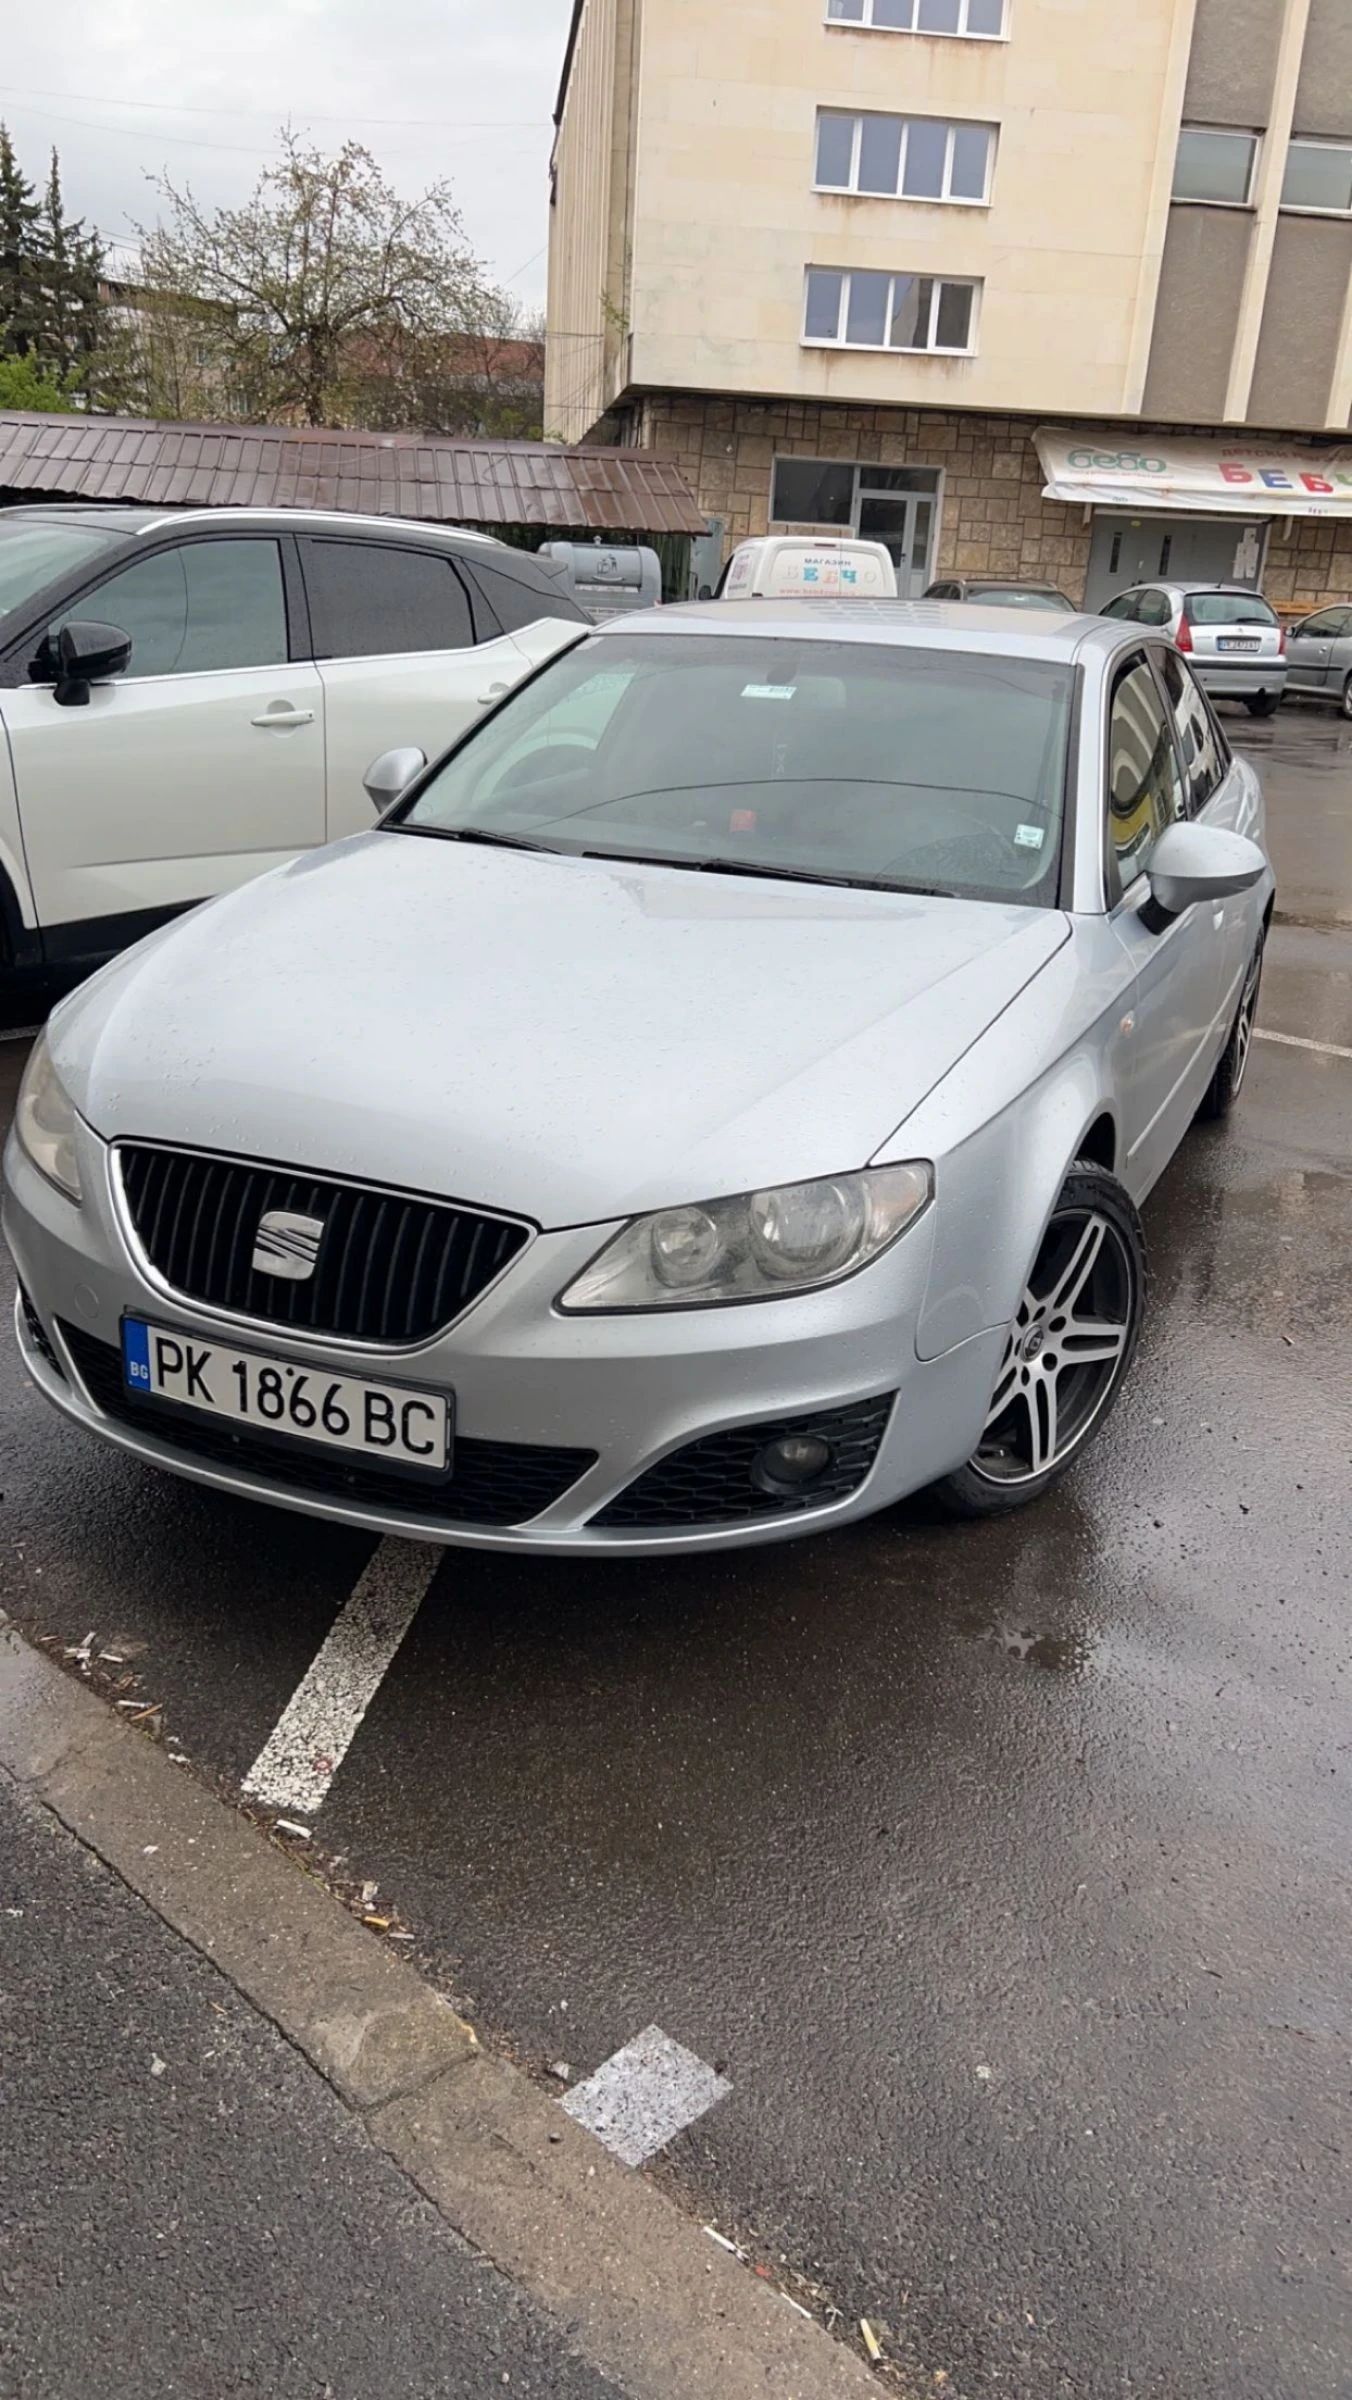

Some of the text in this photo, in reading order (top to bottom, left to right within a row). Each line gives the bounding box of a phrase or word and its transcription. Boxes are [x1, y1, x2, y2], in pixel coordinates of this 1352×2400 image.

[130, 1361, 148, 1380] BG
[156, 1336, 435, 1455] PK 1866 BC
